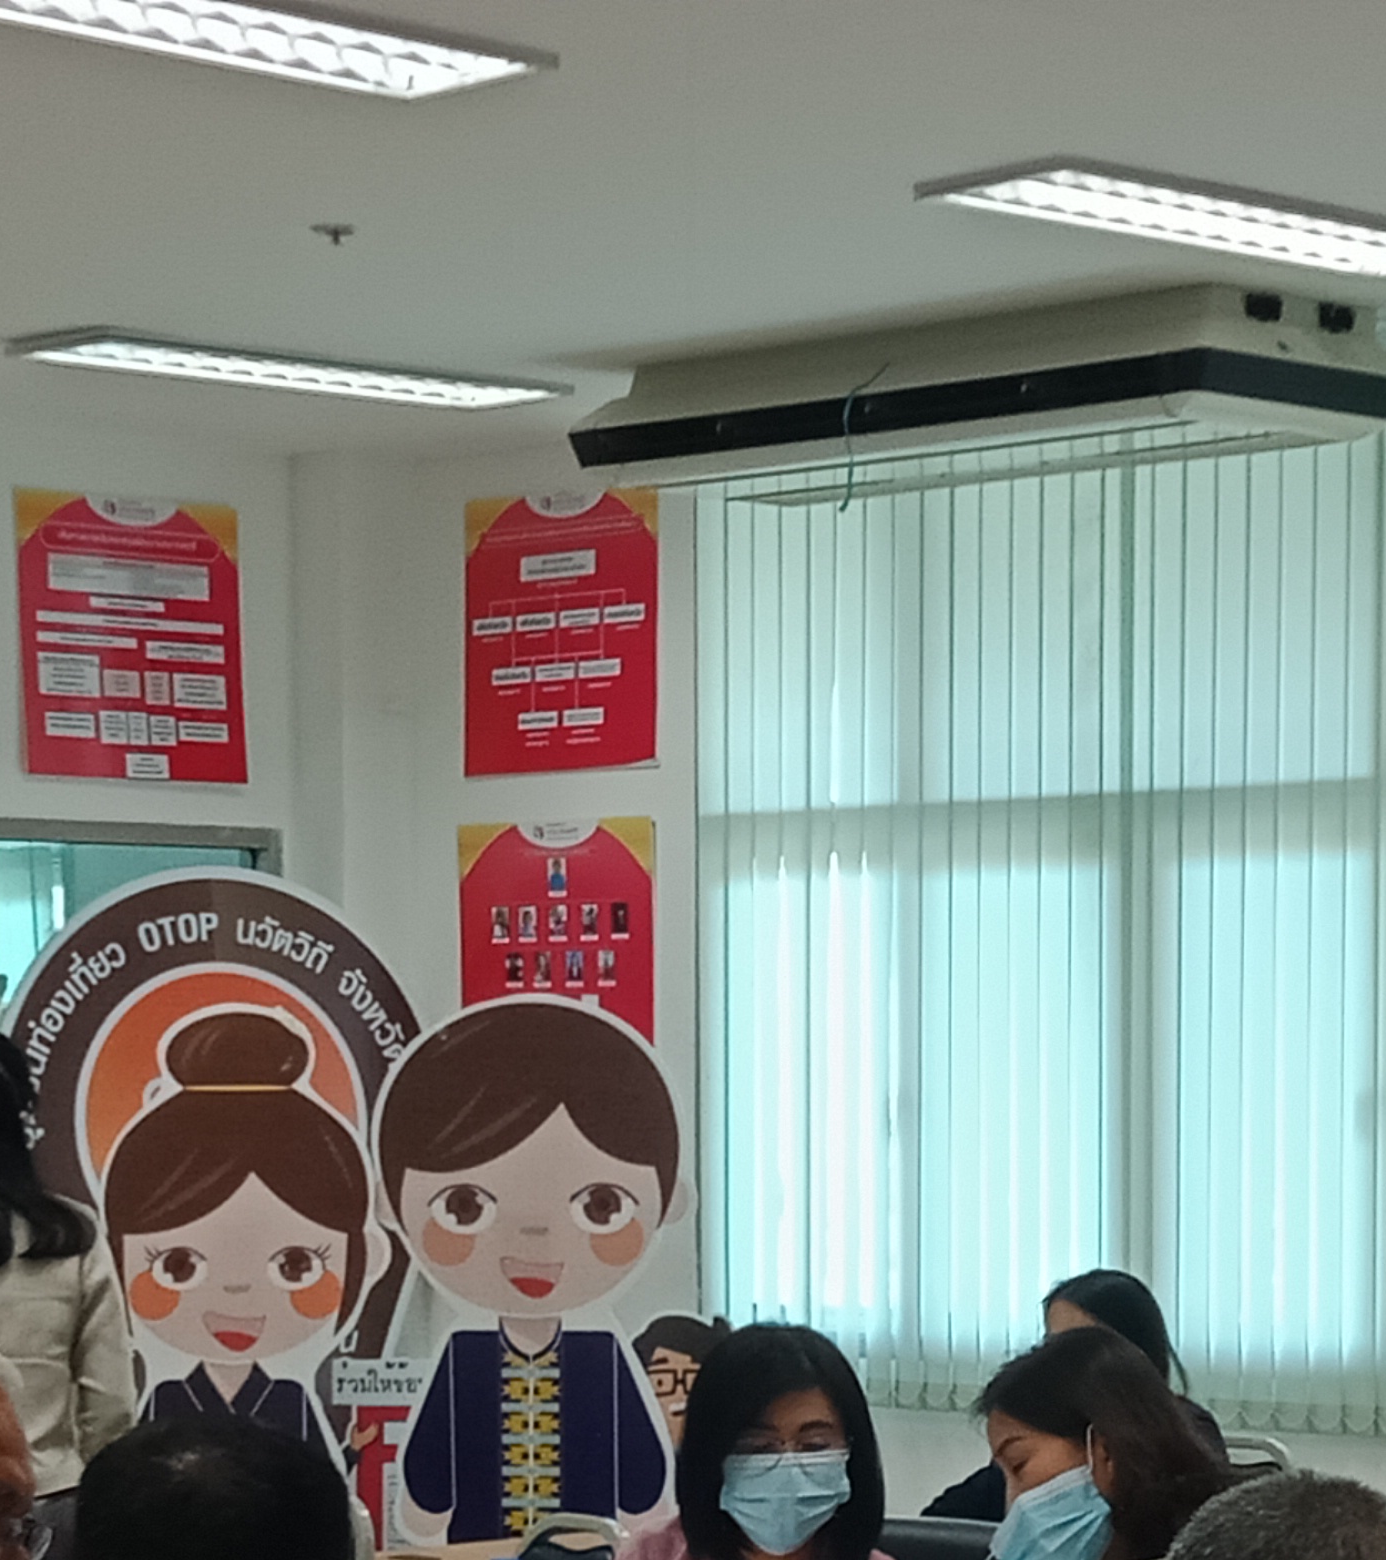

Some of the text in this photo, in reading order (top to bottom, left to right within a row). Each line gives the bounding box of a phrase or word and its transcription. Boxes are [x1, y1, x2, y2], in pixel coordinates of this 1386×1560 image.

[138, 912, 219, 953] OTOP
[236, 916, 335, 974] นวัตวิถี
